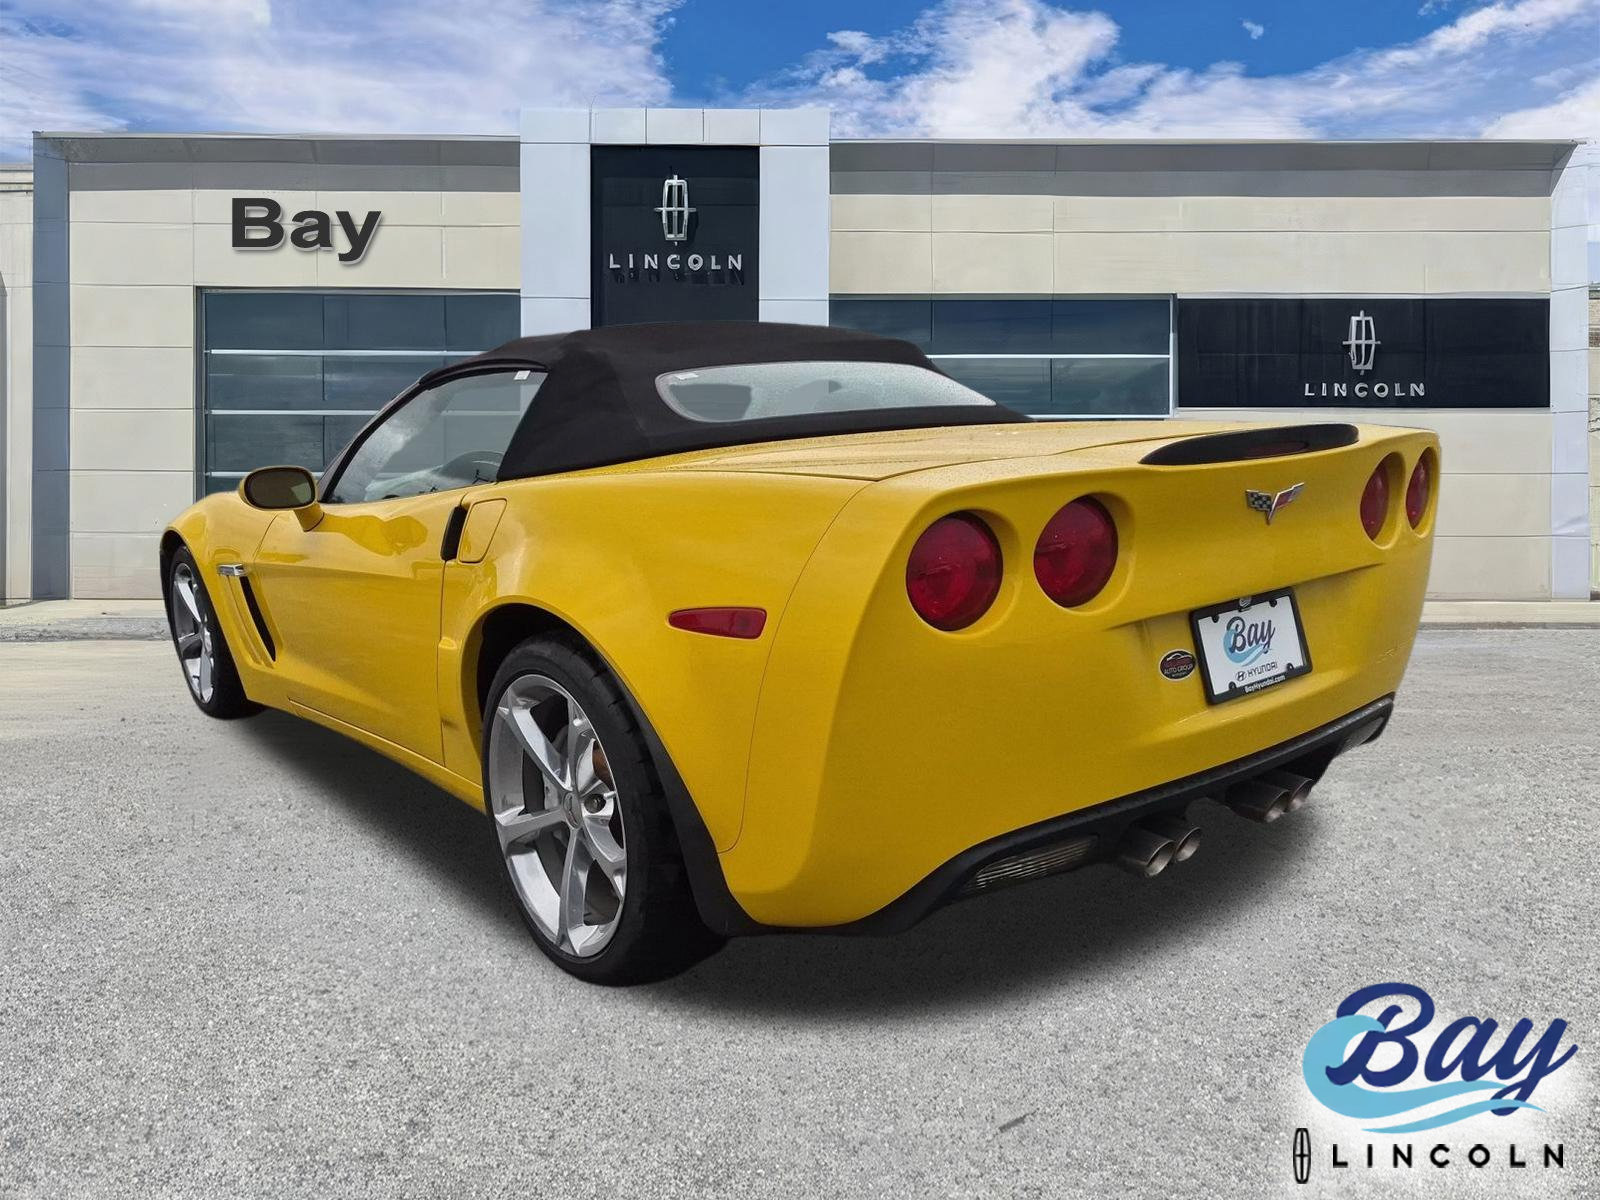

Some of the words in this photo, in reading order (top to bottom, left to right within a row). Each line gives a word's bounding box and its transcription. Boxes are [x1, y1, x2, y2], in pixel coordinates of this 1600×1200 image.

[232, 197, 382, 263] Bay
[609, 253, 743, 271] LINCOLN
[1304, 382, 1425, 398] LINCOLN
[1226, 616, 1276, 654] Bay
[1247, 662, 1278, 677] HYUNDAI
